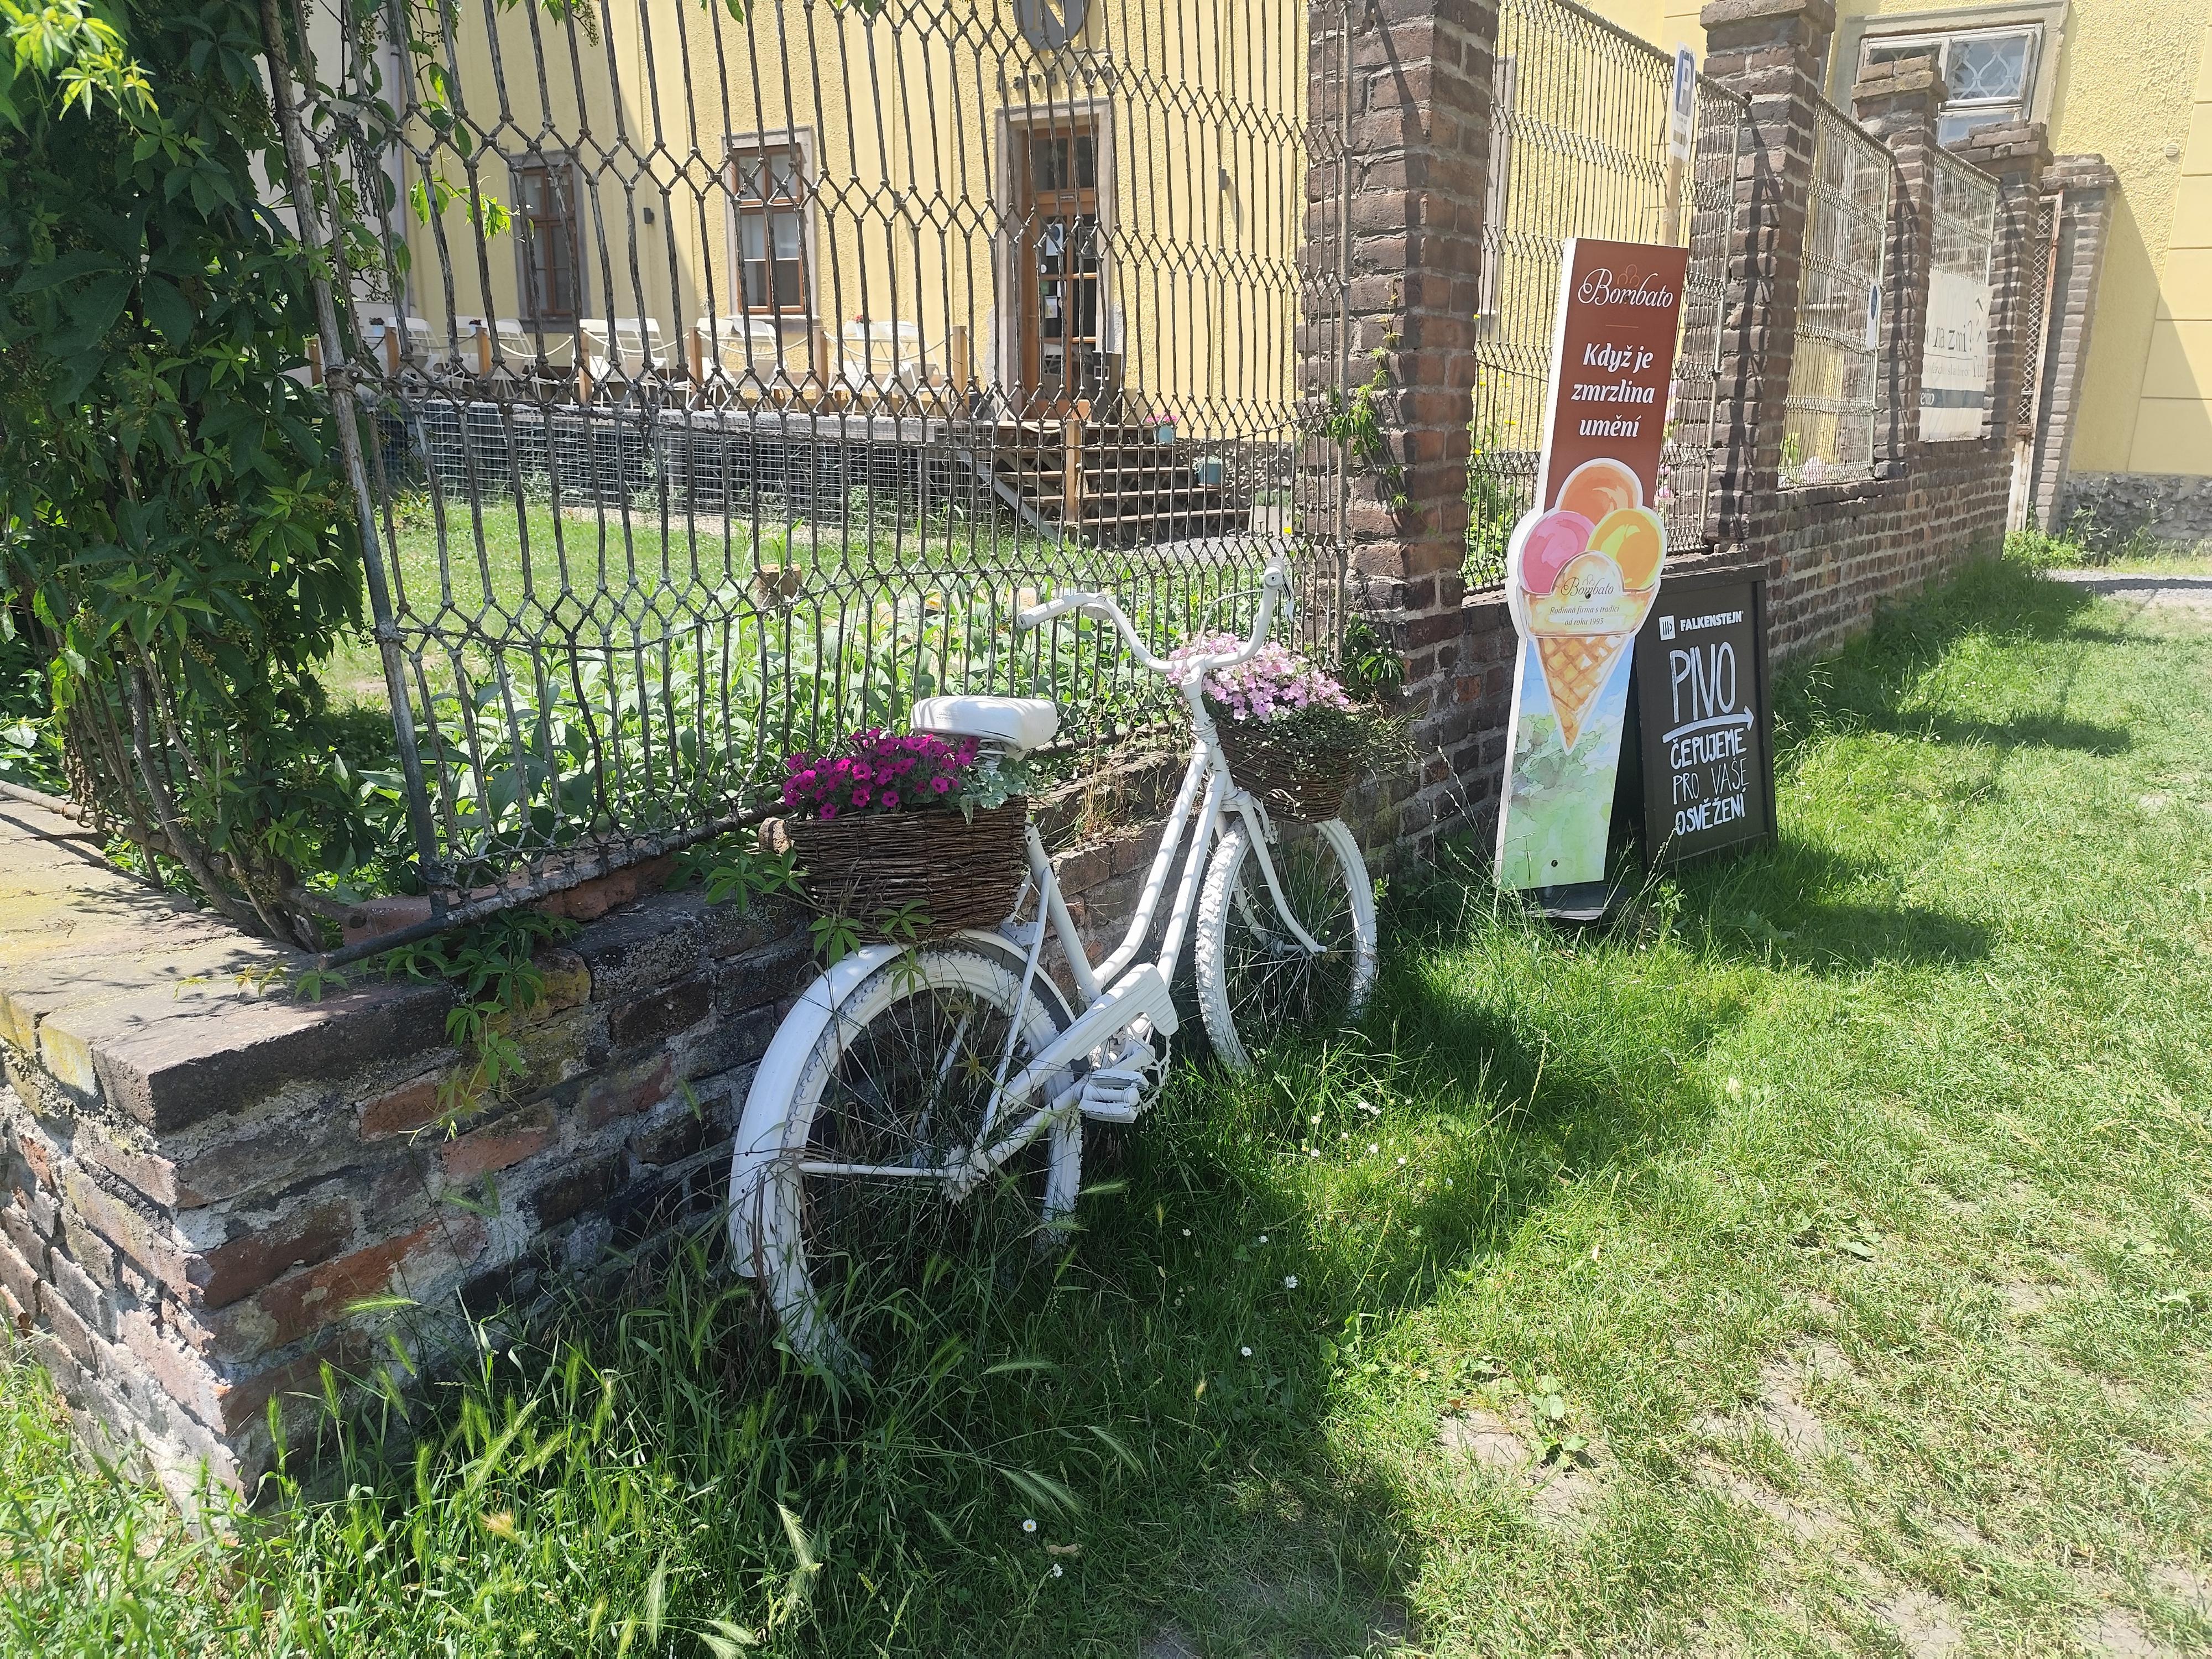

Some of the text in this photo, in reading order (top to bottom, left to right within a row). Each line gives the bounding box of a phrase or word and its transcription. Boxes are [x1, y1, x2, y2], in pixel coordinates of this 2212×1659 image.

[1583, 342, 1654, 374] Když je
[1571, 378, 1656, 404] zmrzlina
[1579, 414, 1642, 437] umění
[1577, 606, 1594, 615] firma
[1680, 610, 1743, 632] FALKENSTEJN
[1669, 641, 1736, 723] PIVO
[1670, 727, 1747, 770] ČEPUJEME
[1672, 757, 1750, 805] PRO VAŠE
[1674, 787, 1746, 837] OSVĚŽENÍ
